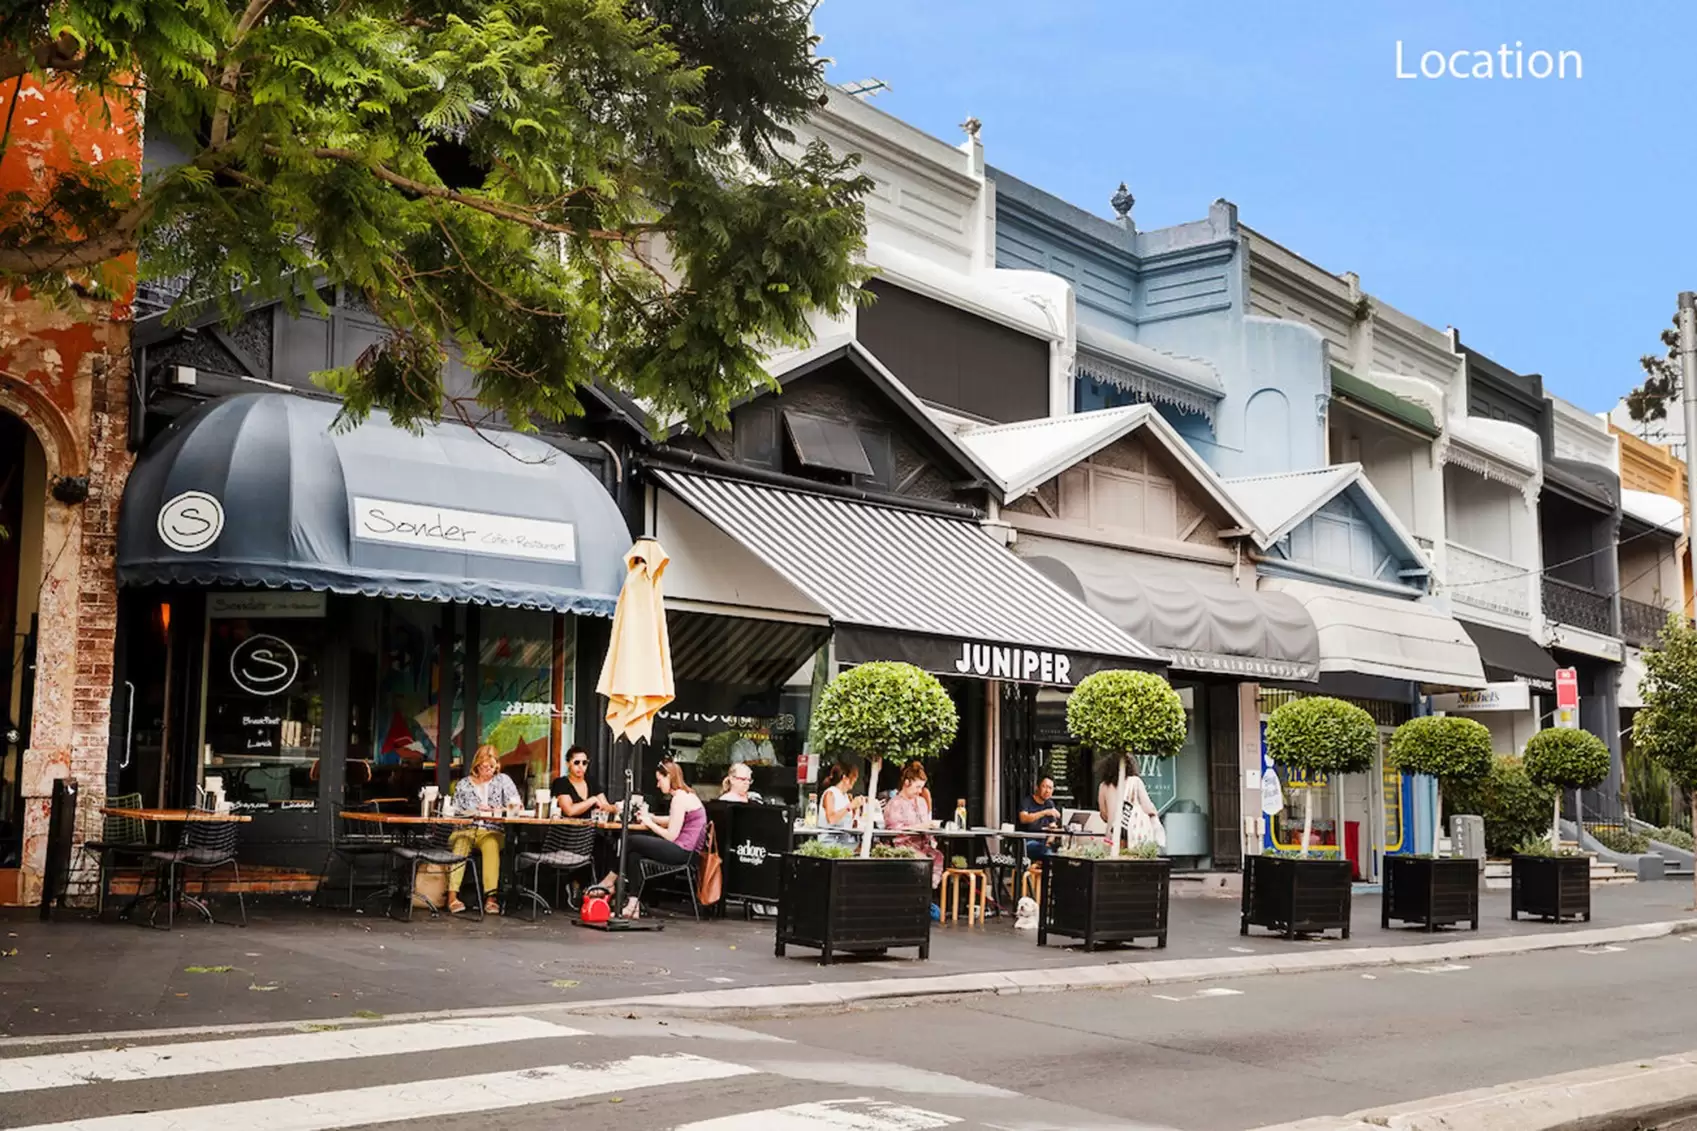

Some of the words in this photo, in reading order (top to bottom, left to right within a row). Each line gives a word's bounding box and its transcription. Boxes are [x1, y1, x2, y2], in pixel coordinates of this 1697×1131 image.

[172, 508, 211, 536] S
[364, 509, 476, 541] Sonder
[242, 649, 287, 682] S
[955, 643, 1071, 683] JUNIPER
[736, 839, 767, 859] adore
